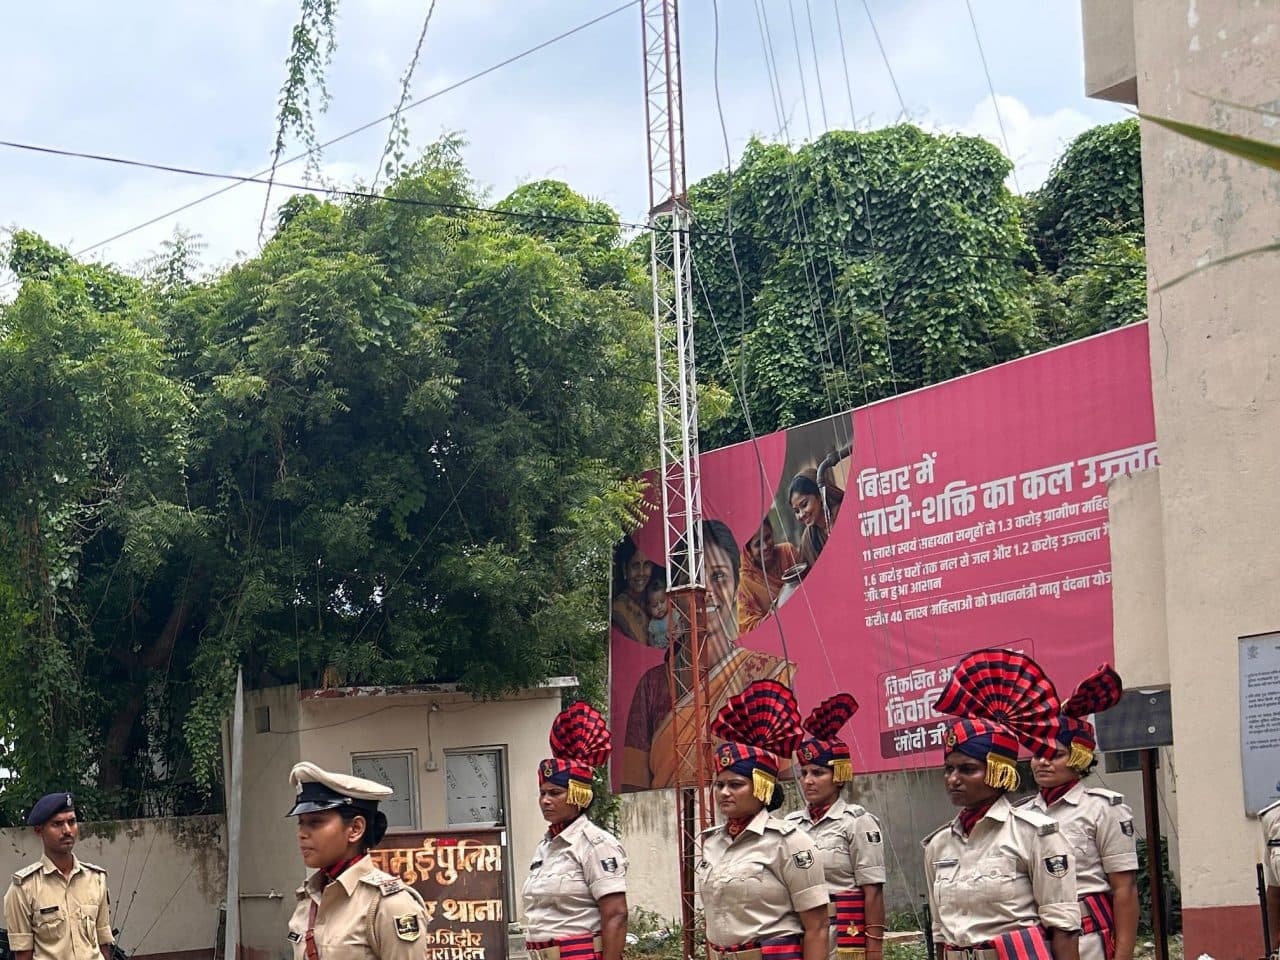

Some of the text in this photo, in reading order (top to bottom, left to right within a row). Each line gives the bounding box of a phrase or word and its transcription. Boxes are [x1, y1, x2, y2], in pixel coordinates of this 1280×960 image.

[857, 452, 937, 501] बिहार में
[858, 480, 977, 536] नारी-शक्ति
[981, 476, 1016, 510] का
[1019, 461, 1074, 500] कल
[863, 550, 871, 561] 11
[872, 545, 895, 560] लाख
[897, 537, 917, 555] स्वयं
[918, 532, 953, 550] सहायता
[986, 519, 996, 535] से
[997, 518, 1012, 533] 1.3
[1014, 511, 1042, 527] करोड़
[1044, 502, 1080, 522] ग्रामीण
[864, 574, 877, 587] 1.6
[879, 567, 902, 583] करोड़
[922, 561, 938, 575] तक
[939, 558, 957, 571] नल
[959, 552, 970, 567] से
[971, 550, 991, 564] जल
[992, 545, 1012, 560] और
[1013, 542, 1029, 556] 1.2
[1031, 535, 1059, 551] करोड़
[890, 610, 902, 623] 40
[904, 606, 928, 620] लाख
[974, 592, 989, 608] को
[990, 582, 1037, 605] प्रधानमंत्री
[1039, 580, 1060, 599] मातृ
[1061, 576, 1090, 591] वंदना
[910, 577, 942, 593] आसान
[885, 669, 936, 697] विकसित
[894, 728, 926, 752] मोदी
[442, 899, 502, 922] थाना
